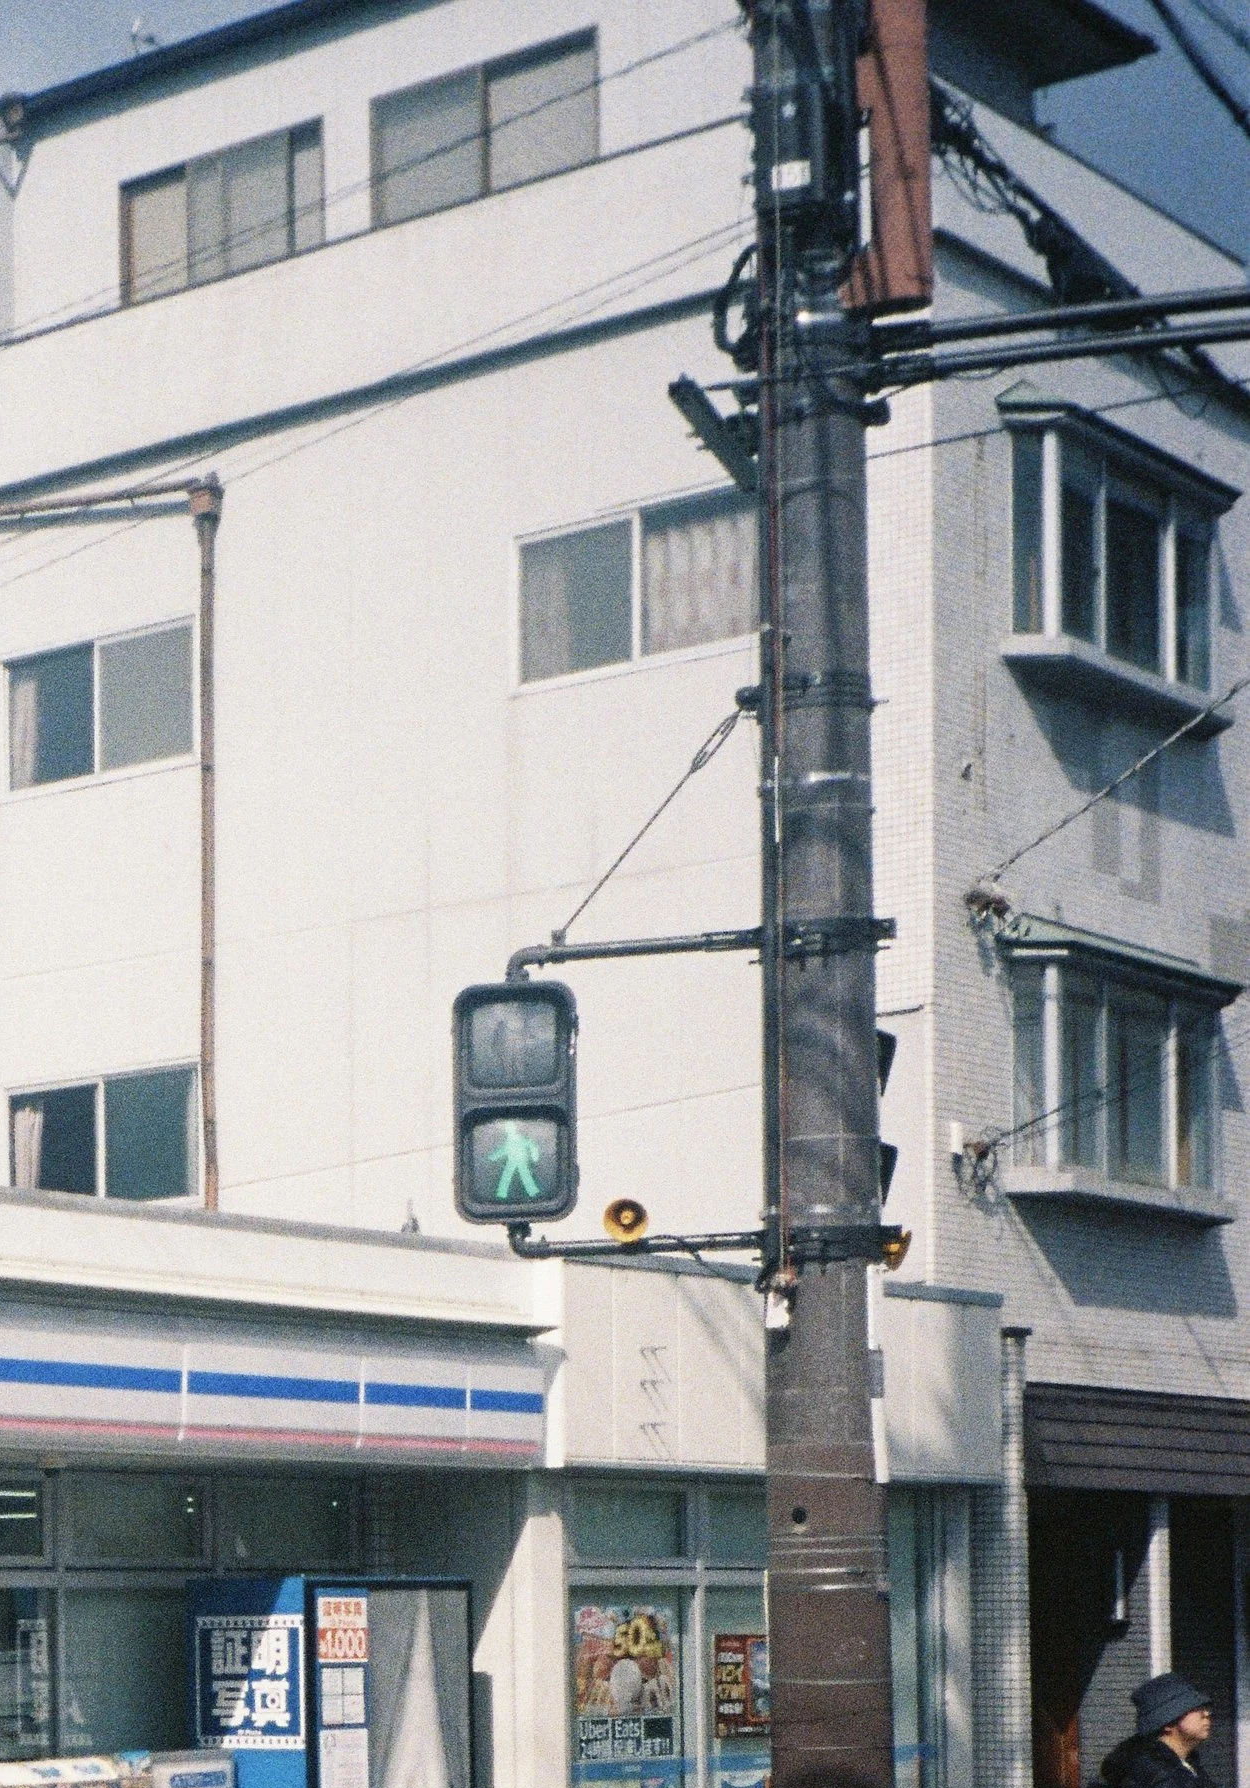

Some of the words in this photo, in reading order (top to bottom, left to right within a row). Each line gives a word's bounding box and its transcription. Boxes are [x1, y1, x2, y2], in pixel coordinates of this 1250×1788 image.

[211, 1629, 289, 1676] 証明
[211, 1677, 291, 1728] 写真
[580, 1720, 609, 1740] Uber
[615, 1719, 641, 1739] Eats
